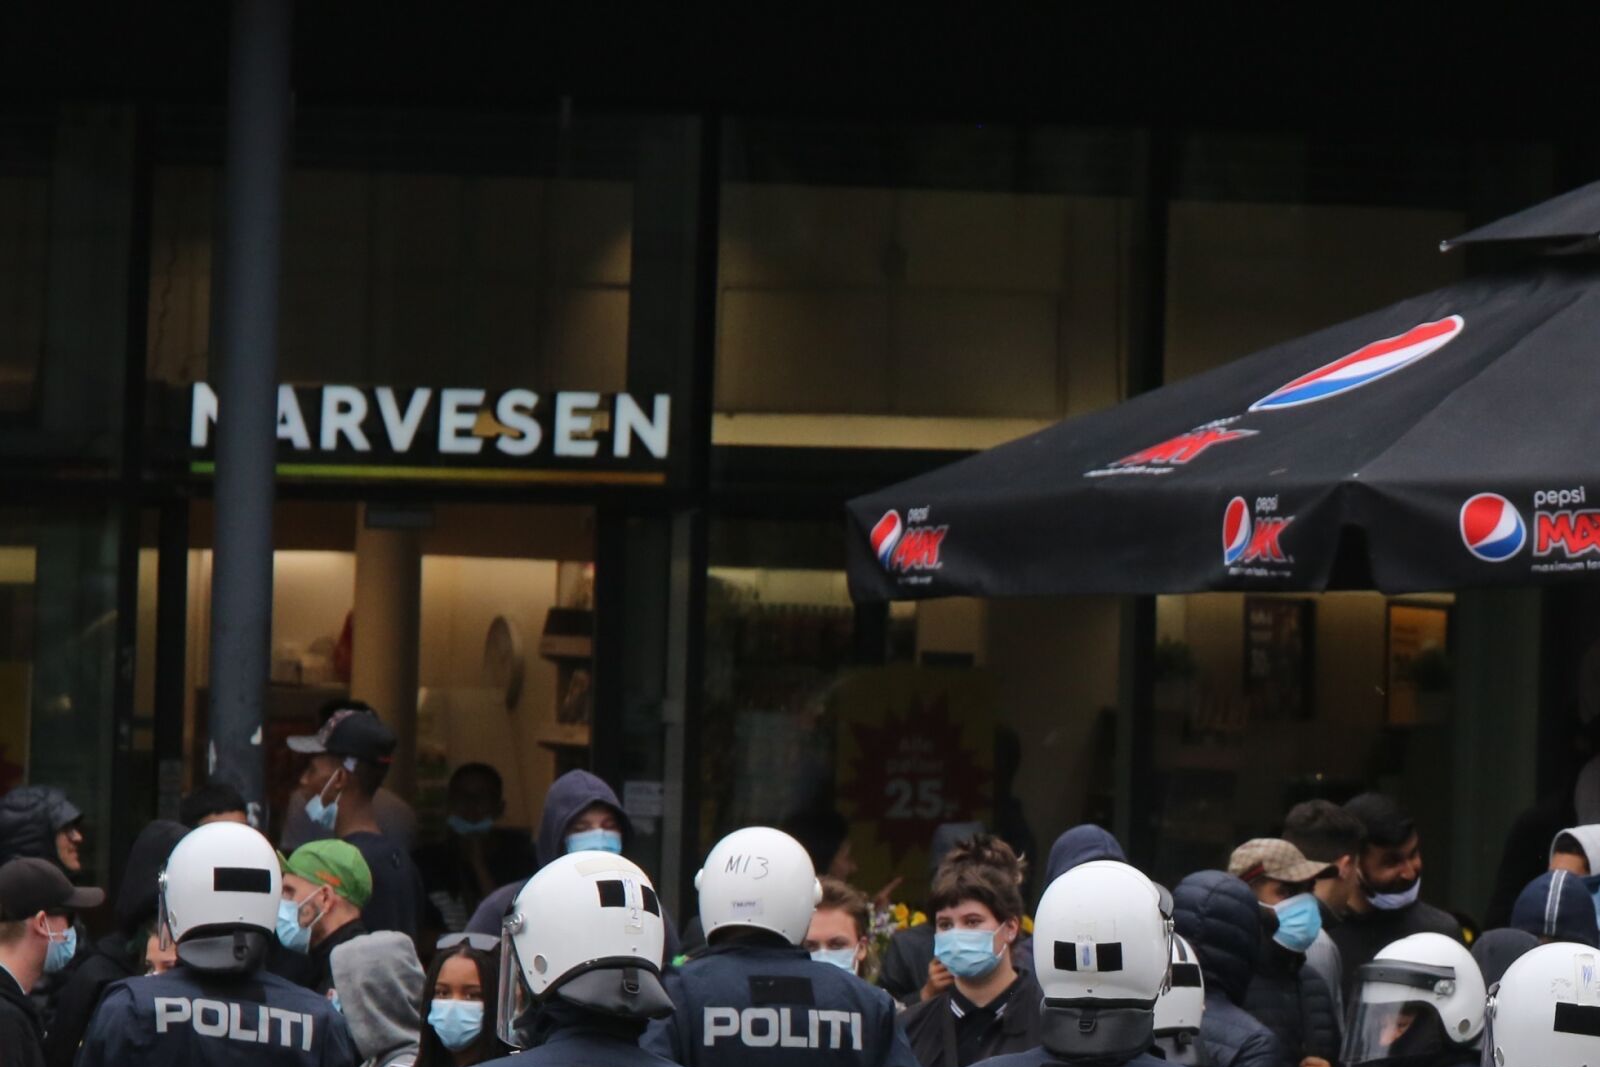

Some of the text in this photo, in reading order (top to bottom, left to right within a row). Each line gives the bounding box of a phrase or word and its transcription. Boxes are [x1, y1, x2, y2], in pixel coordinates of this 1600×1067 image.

[1534, 485, 1586, 508] pepsi
[1531, 560, 1585, 572] maximum
[724, 854, 770, 880] M13
[154, 996, 314, 1052] POLITI
[703, 1006, 863, 1051] POLITI
